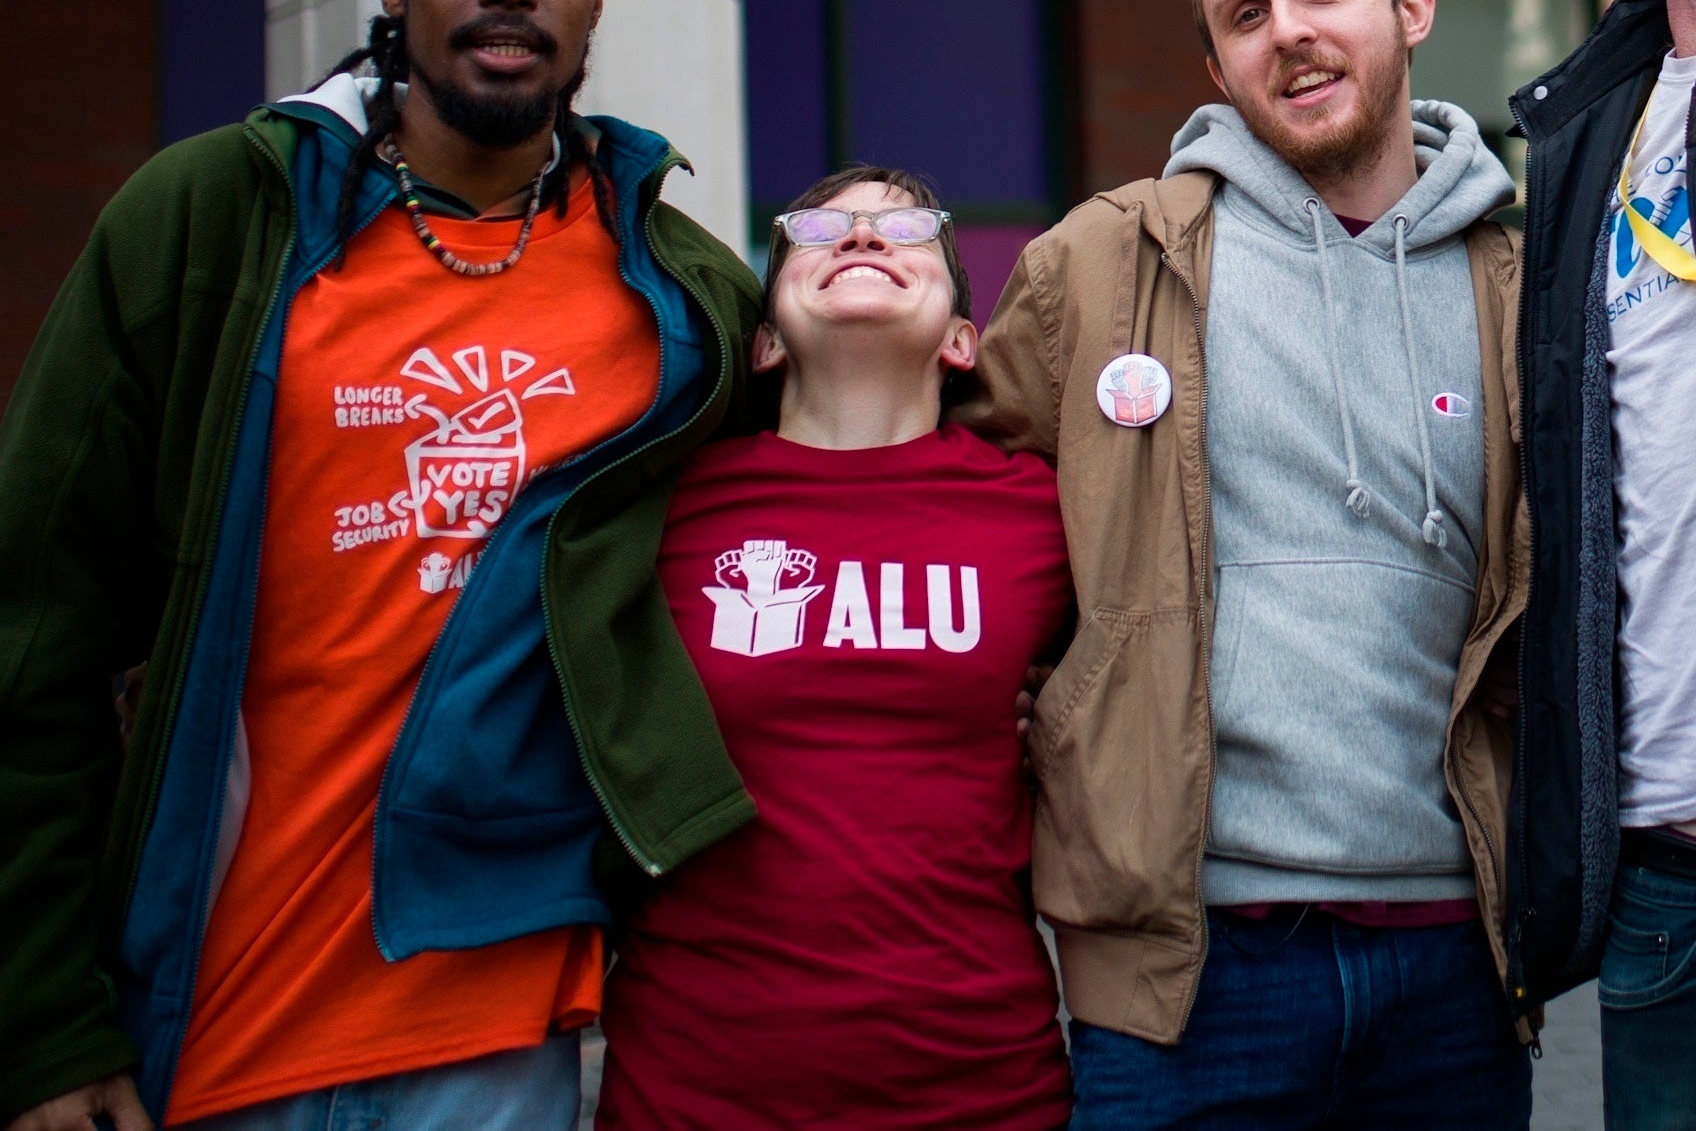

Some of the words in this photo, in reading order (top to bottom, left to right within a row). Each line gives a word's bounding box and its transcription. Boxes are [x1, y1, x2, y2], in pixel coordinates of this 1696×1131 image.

[333, 386, 403, 406] LONGER
[334, 406, 405, 428] BREAKS
[426, 461, 512, 488] VOTE
[333, 501, 386, 528] JOB
[433, 490, 508, 525] YES
[332, 518, 410, 553] SECURITY
[448, 552, 483, 589] AL
[822, 560, 982, 653] ALU
